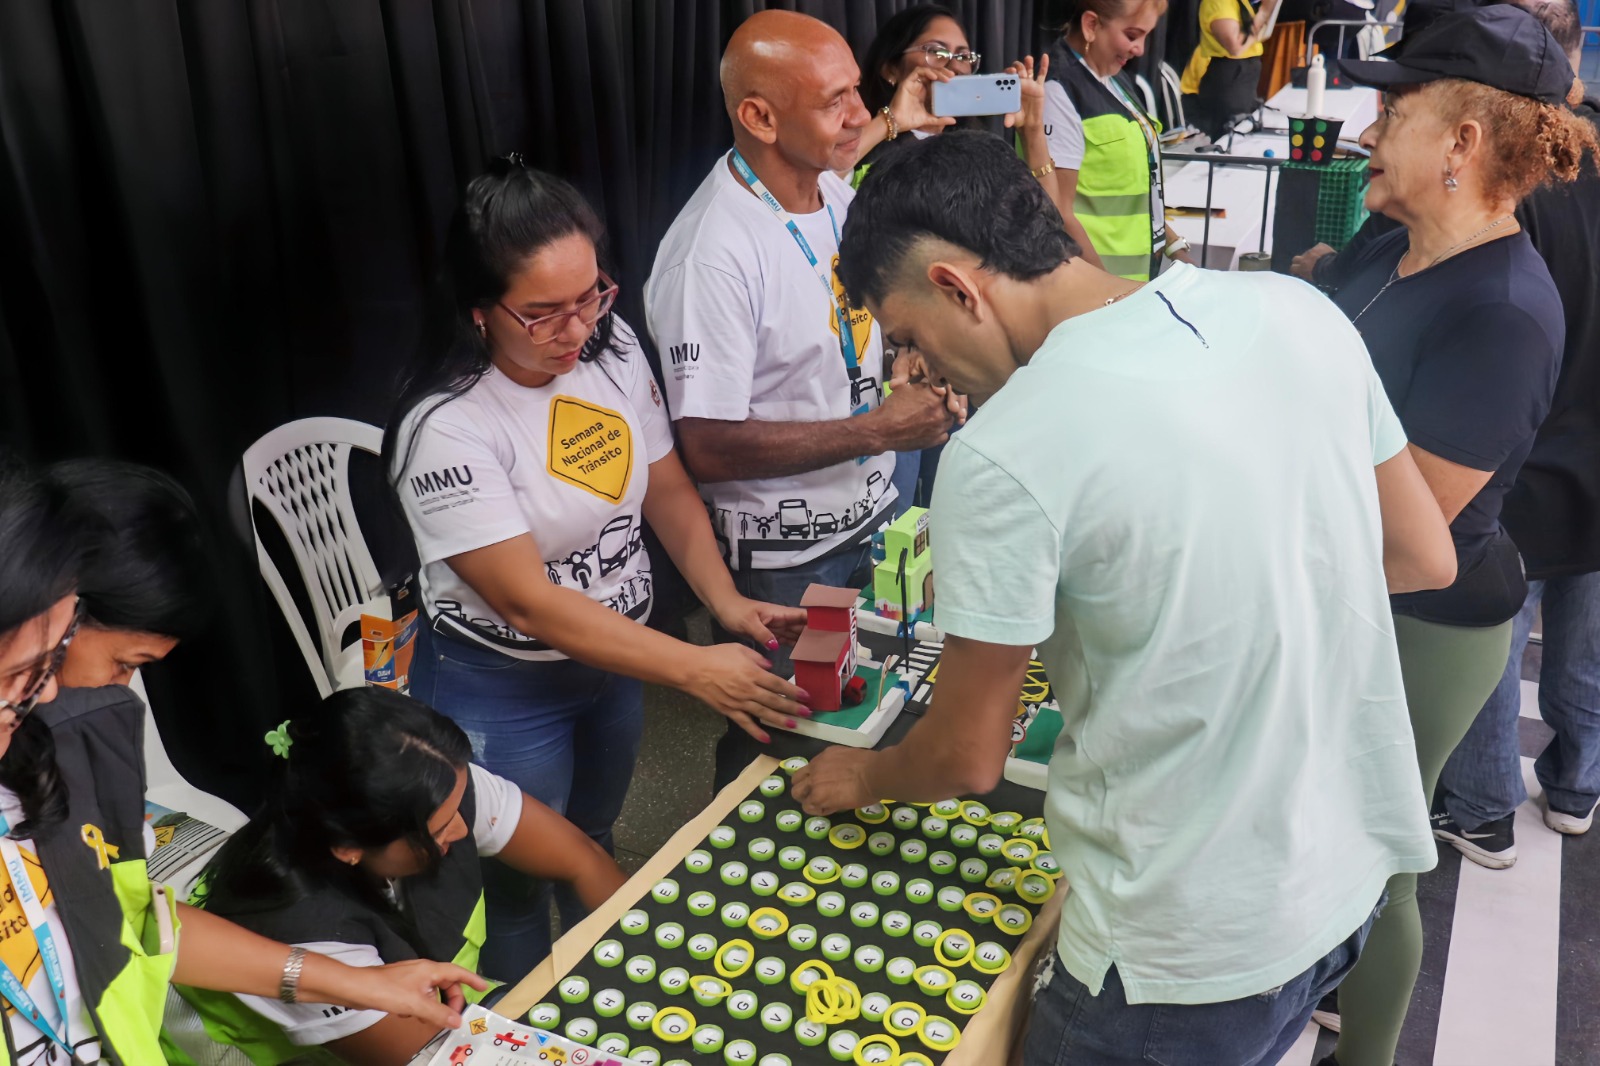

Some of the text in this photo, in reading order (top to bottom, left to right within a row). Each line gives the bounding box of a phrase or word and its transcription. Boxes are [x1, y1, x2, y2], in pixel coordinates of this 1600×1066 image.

[560, 422, 604, 450] Semana
[562, 430, 621, 467] Nacional de
[578, 447, 622, 475] Trânsito
[410, 464, 472, 498] IMMU
[8, 860, 34, 904] IMMU
[984, 952, 996, 960] E
[737, 1001, 749, 1010] G
[764, 967, 775, 976] U
[576, 1029, 588, 1037] U
[602, 997, 615, 1006] H
[870, 1005, 880, 1013] F
[901, 1018, 913, 1026] O
[734, 1051, 748, 1060] K
[770, 1013, 781, 1022] V
[804, 1028, 816, 1037] U
[575, 1052, 585, 1061] E
